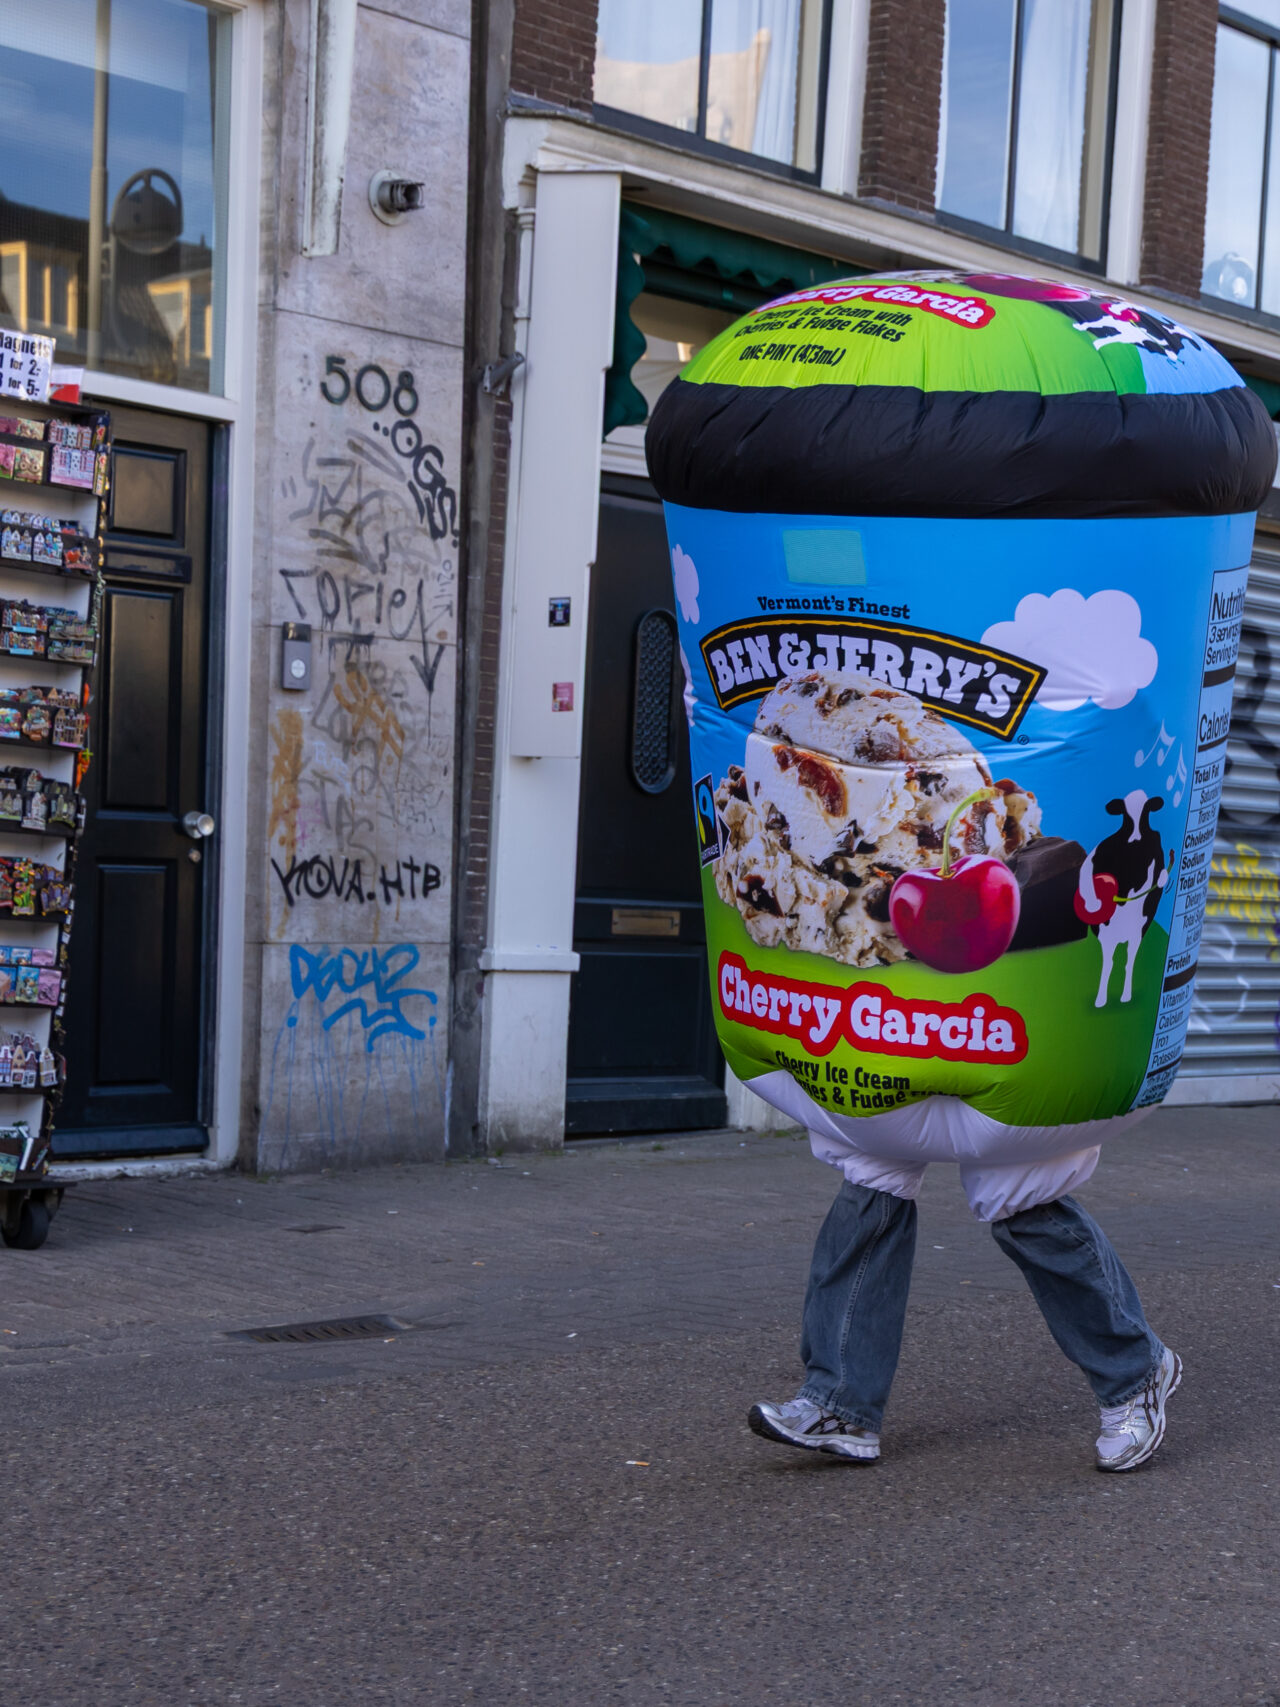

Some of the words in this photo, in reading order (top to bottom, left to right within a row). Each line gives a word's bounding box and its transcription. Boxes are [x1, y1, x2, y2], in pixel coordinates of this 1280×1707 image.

[873, 285, 984, 324] Garcia
[799, 306, 825, 317] Ice
[827, 305, 874, 319] Cream
[875, 310, 913, 326] with
[788, 317, 803, 329] &
[803, 316, 850, 331] Fudge
[851, 320, 906, 343] Flakes
[0, 332, 50, 358] agnets
[739, 343, 765, 361] ONE
[764, 344, 794, 362] PINT
[10, 358, 23, 370] for
[8, 377, 21, 389] for
[320, 355, 419, 417] 508
[757, 596, 845, 611] Vermont's
[847, 597, 911, 619] Finest
[1209, 625, 1217, 643] 3
[1206, 645, 1231, 666] Serving
[710, 633, 778, 694] BEN
[777, 633, 811, 671] &
[814, 633, 1022, 719] JERRY'S
[1199, 707, 1229, 743] Calories
[1195, 769, 1210, 785] Total
[1180, 873, 1196, 891] Total
[1167, 953, 1191, 973] Protein
[721, 963, 842, 1043] Cherry
[850, 994, 1016, 1052] Garcia
[1162, 991, 1185, 1009] Vitamin
[1158, 1010, 1184, 1031] Calcium
[1155, 1034, 1169, 1050] Iron
[825, 1061, 848, 1085] Ice
[854, 1066, 911, 1090] Cream
[832, 1087, 845, 1106] &
[850, 1088, 907, 1109] Fudge
